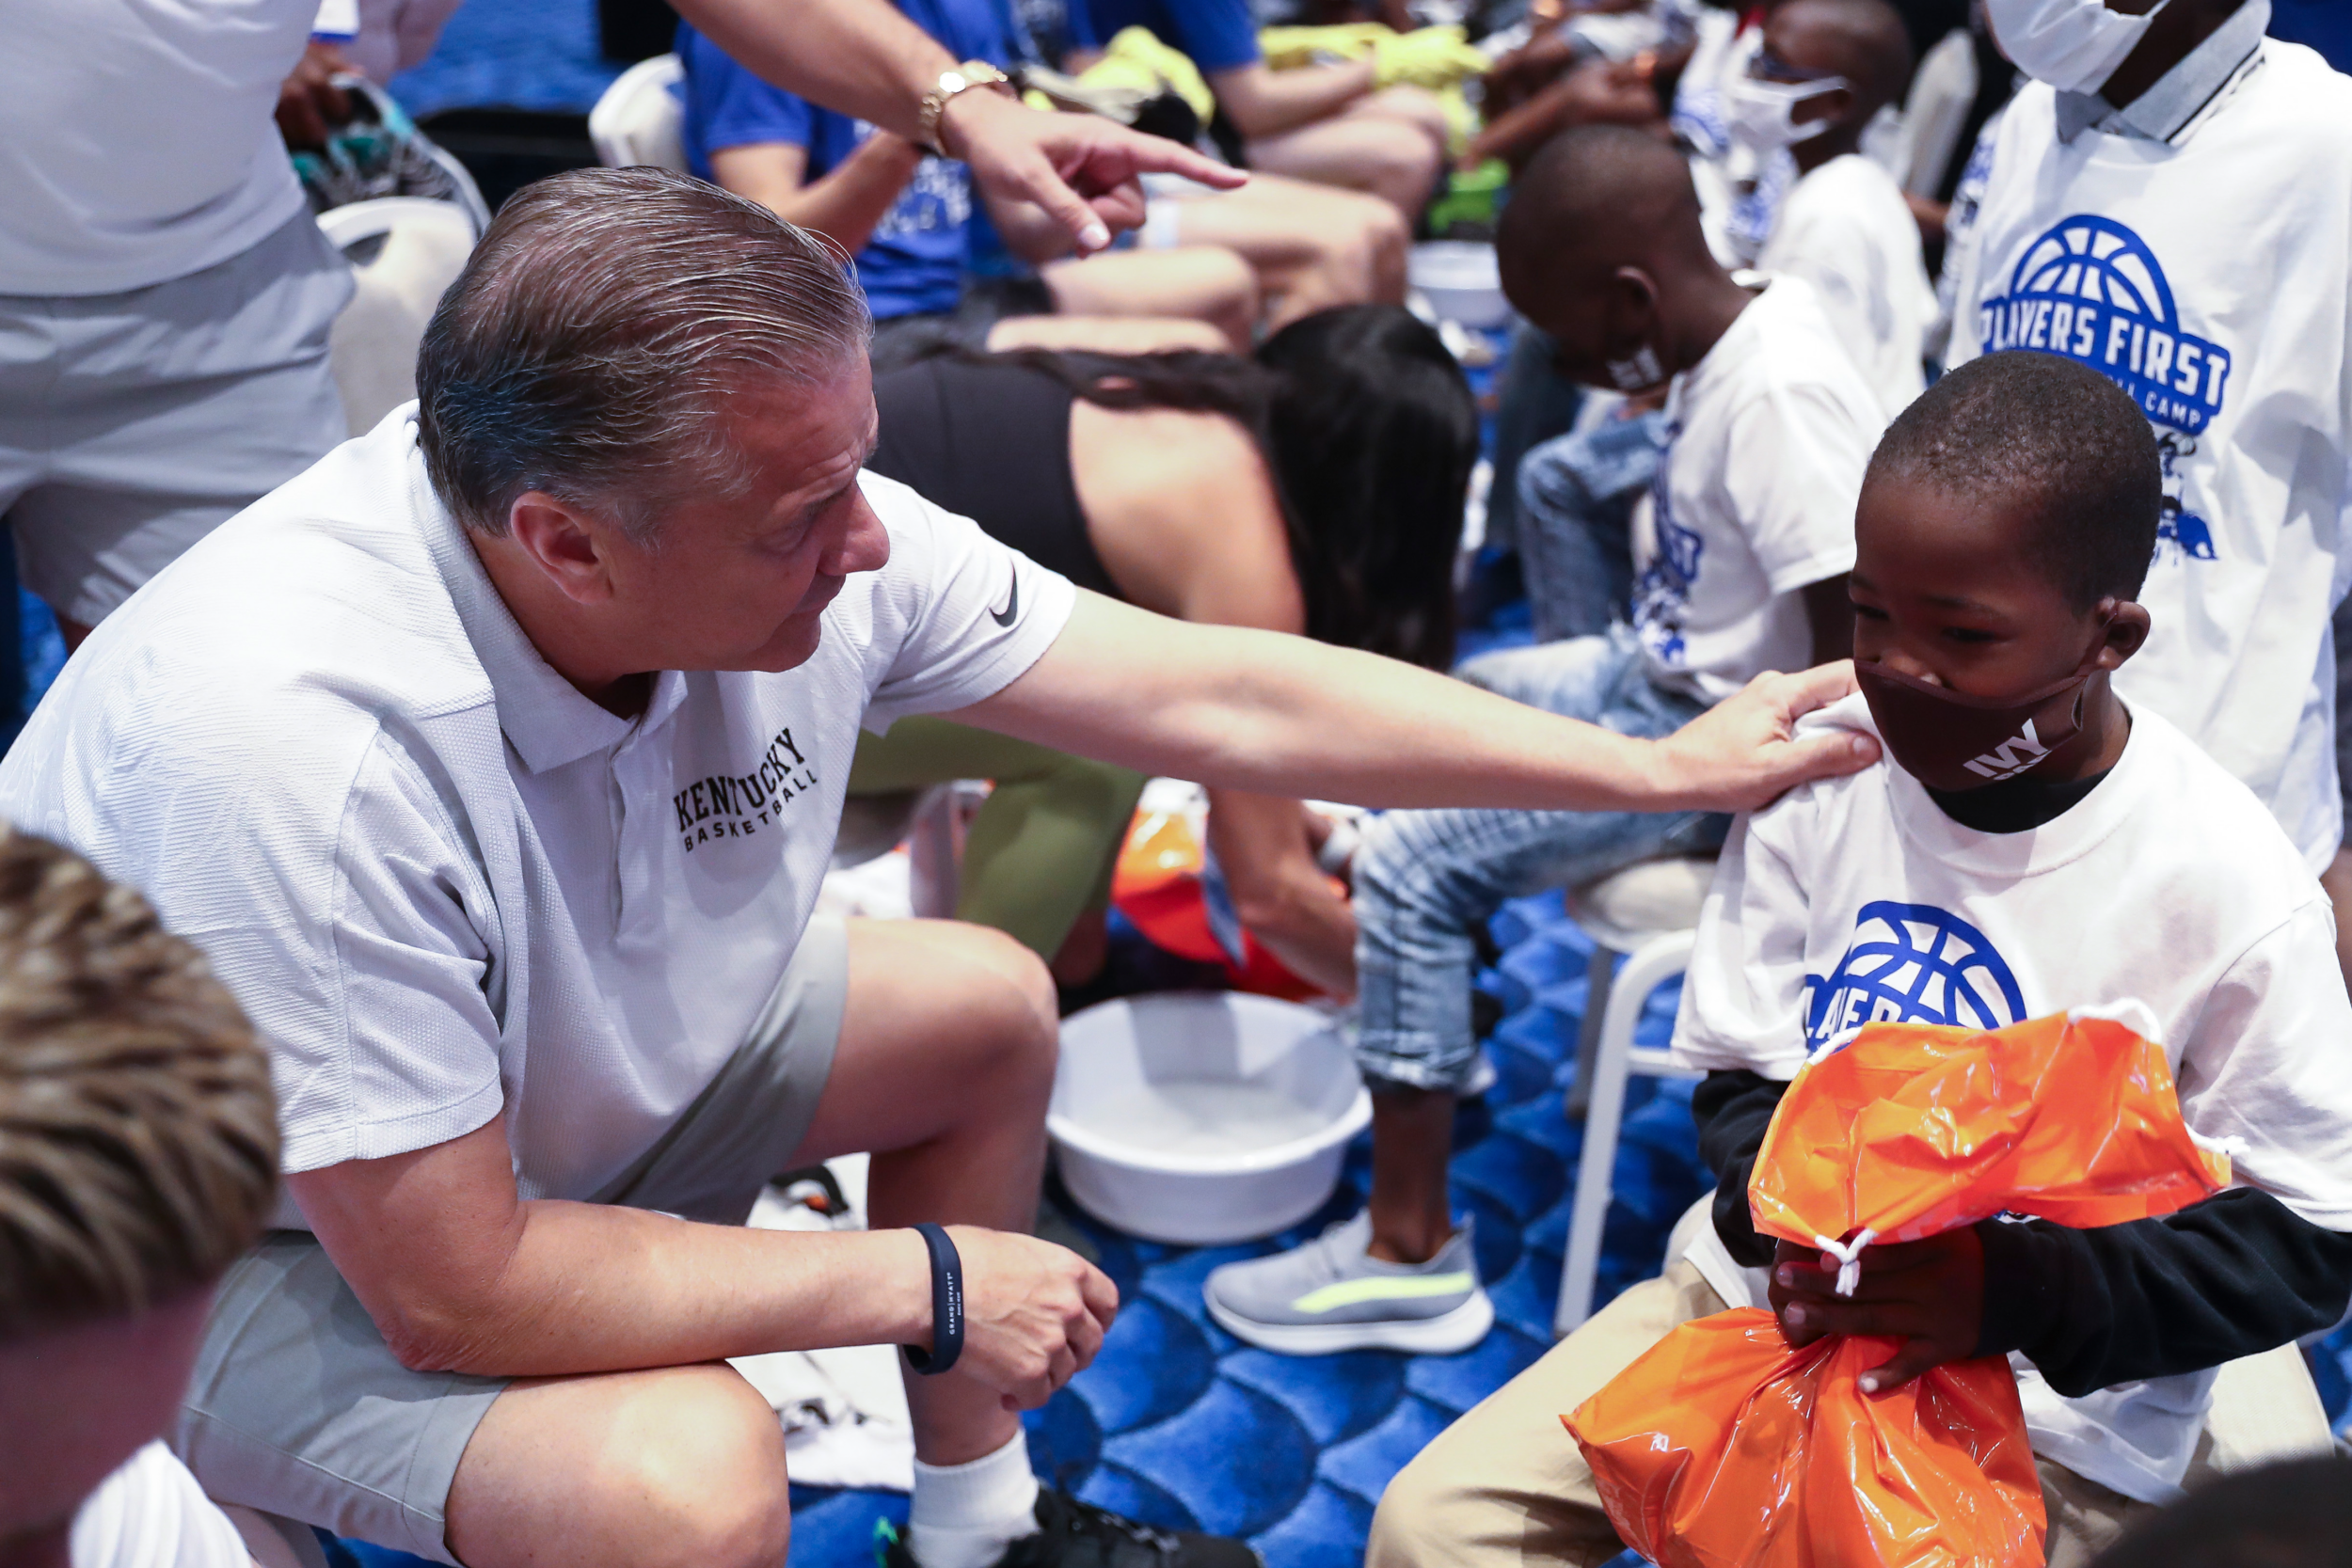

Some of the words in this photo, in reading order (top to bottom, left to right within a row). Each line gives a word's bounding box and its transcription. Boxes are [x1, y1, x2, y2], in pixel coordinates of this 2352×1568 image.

[2104, 314, 2228, 407] FIRST
[2144, 390, 2202, 429] CAMP
[673, 727, 805, 832] KENTUCKY
[1963, 718, 2049, 778] IVY
[684, 769, 818, 852] BASKETBALL
